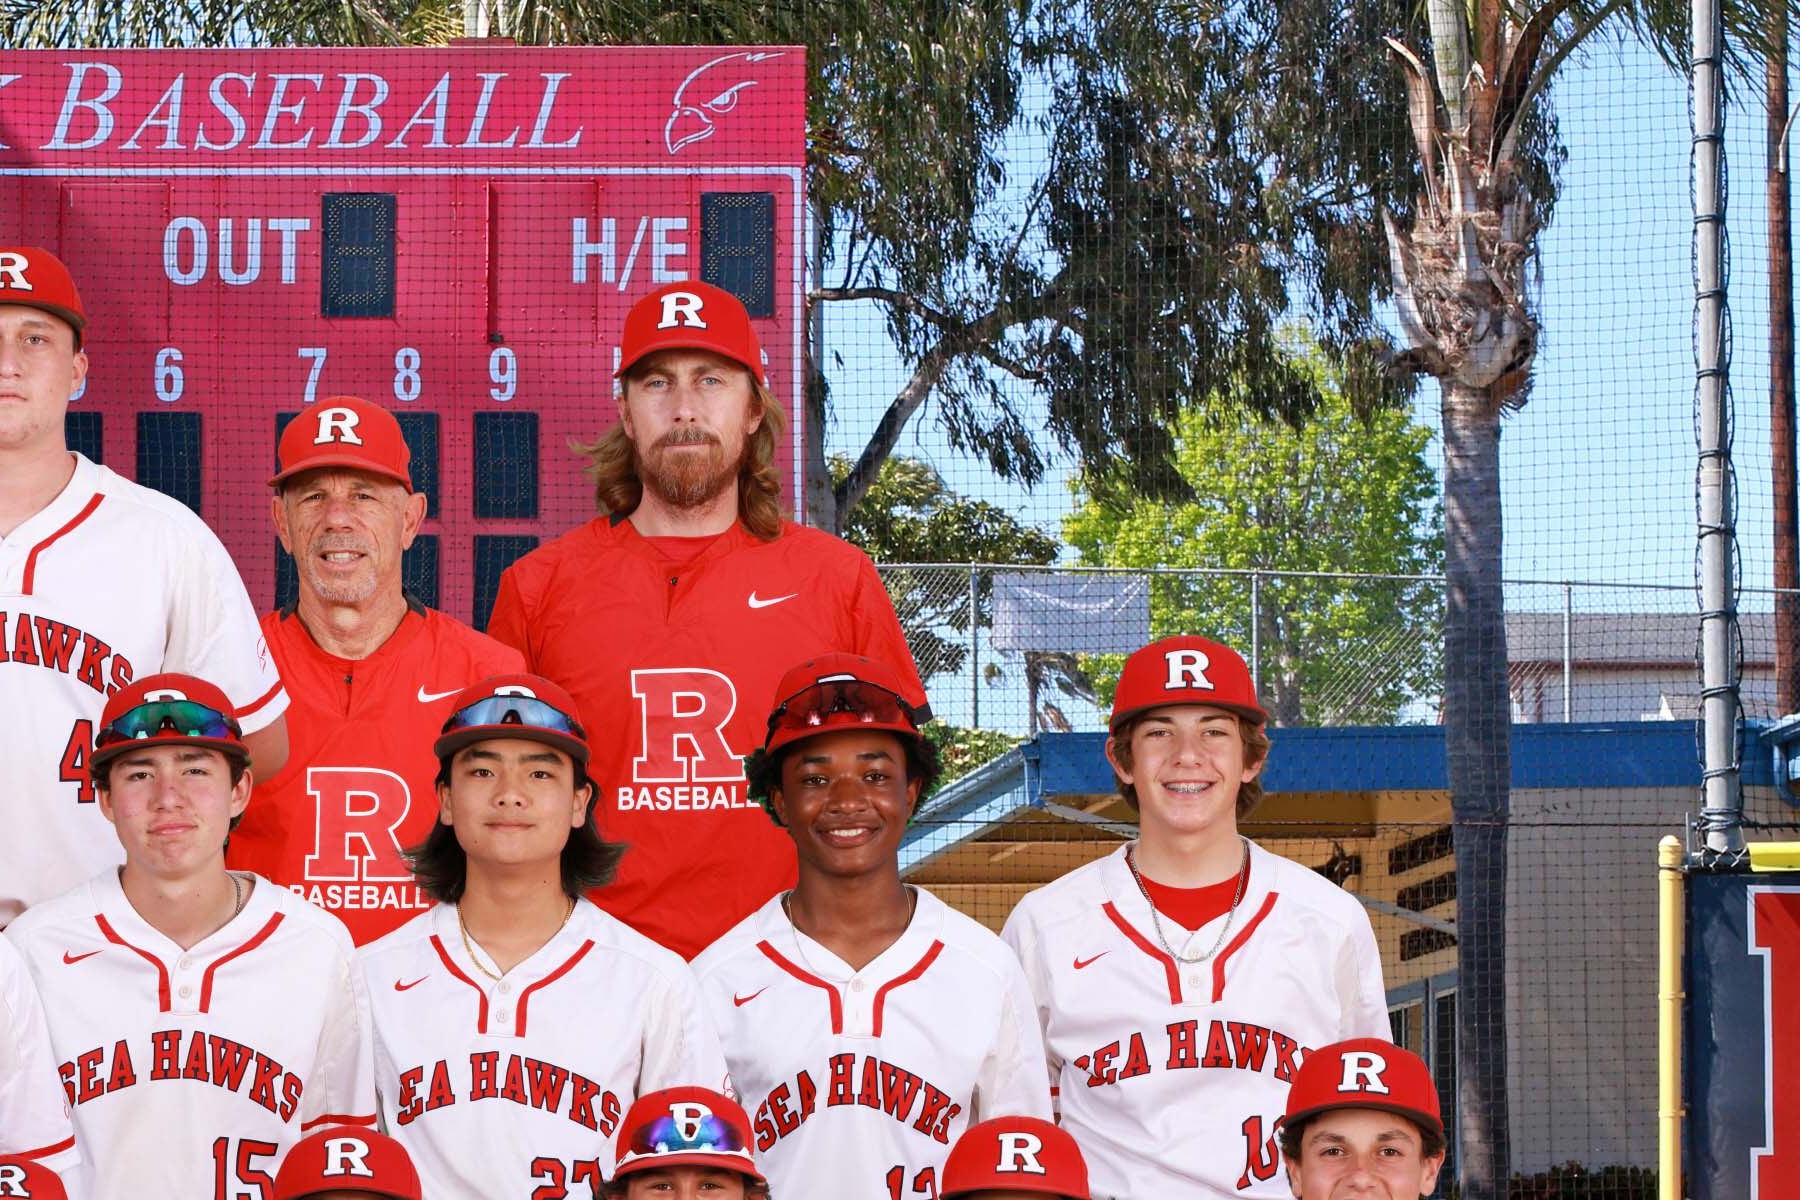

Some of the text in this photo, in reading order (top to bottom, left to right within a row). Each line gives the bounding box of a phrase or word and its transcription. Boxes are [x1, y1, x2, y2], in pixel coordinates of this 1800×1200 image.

[40, 62, 584, 151] BASEBALL
[163, 216, 311, 285] OUT
[572, 216, 688, 292] H/E
[656, 291, 708, 330] R
[155, 348, 185, 402] 6
[298, 348, 327, 402] 7
[394, 348, 422, 402] 8
[488, 347, 517, 402] 9
[313, 408, 364, 446] R
[1165, 648, 1214, 691] R
[630, 668, 746, 783] R
[304, 767, 415, 883] R
[59, 1029, 304, 1124] SEA HAWKS
[469, 1051, 621, 1139] HAWKS
[1336, 1051, 1390, 1096] R
[754, 1053, 962, 1152] SEA HAWKS
[323, 1137, 374, 1178] R
[995, 1132, 1045, 1175] R
